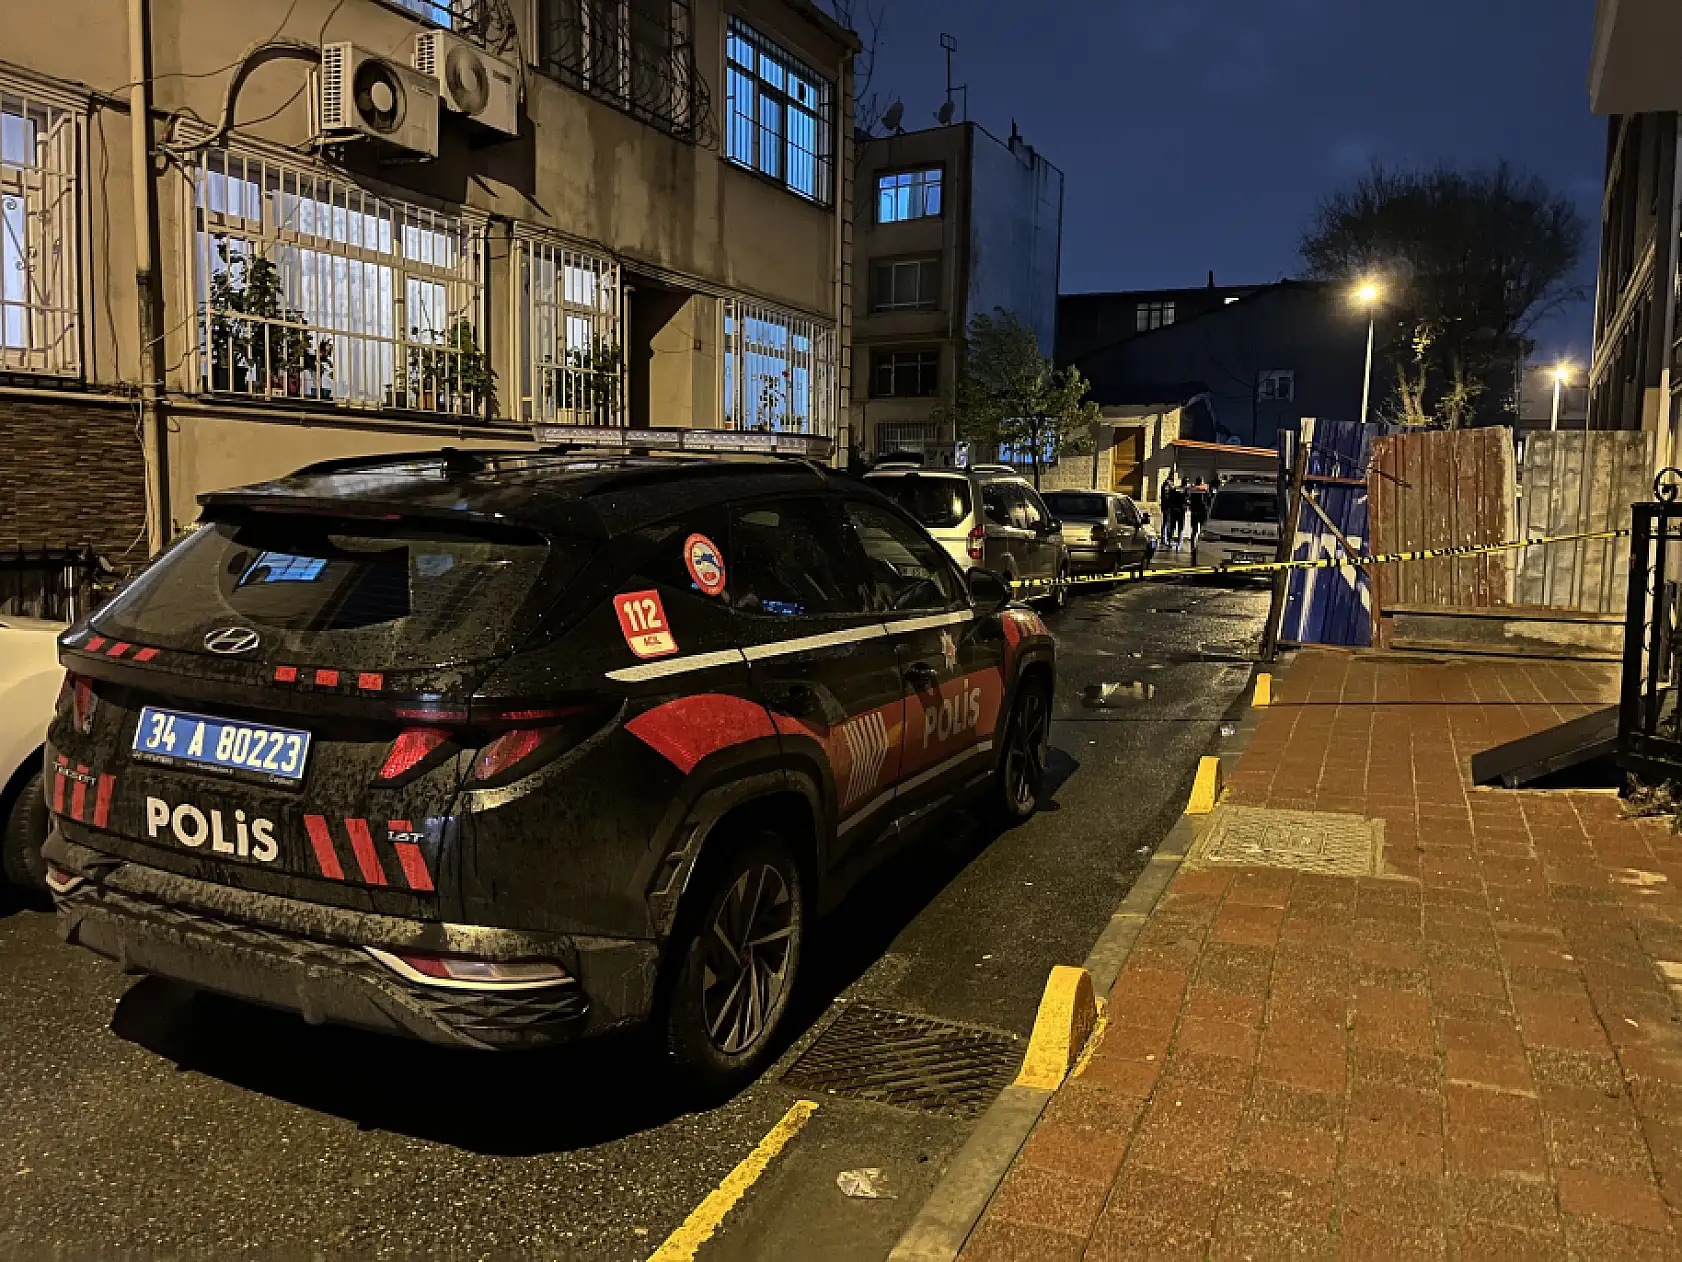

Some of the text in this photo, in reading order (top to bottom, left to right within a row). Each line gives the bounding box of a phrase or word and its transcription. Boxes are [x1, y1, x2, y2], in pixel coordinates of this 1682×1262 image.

[623, 597, 663, 632] 112
[146, 712, 302, 772] 34 A 80223
